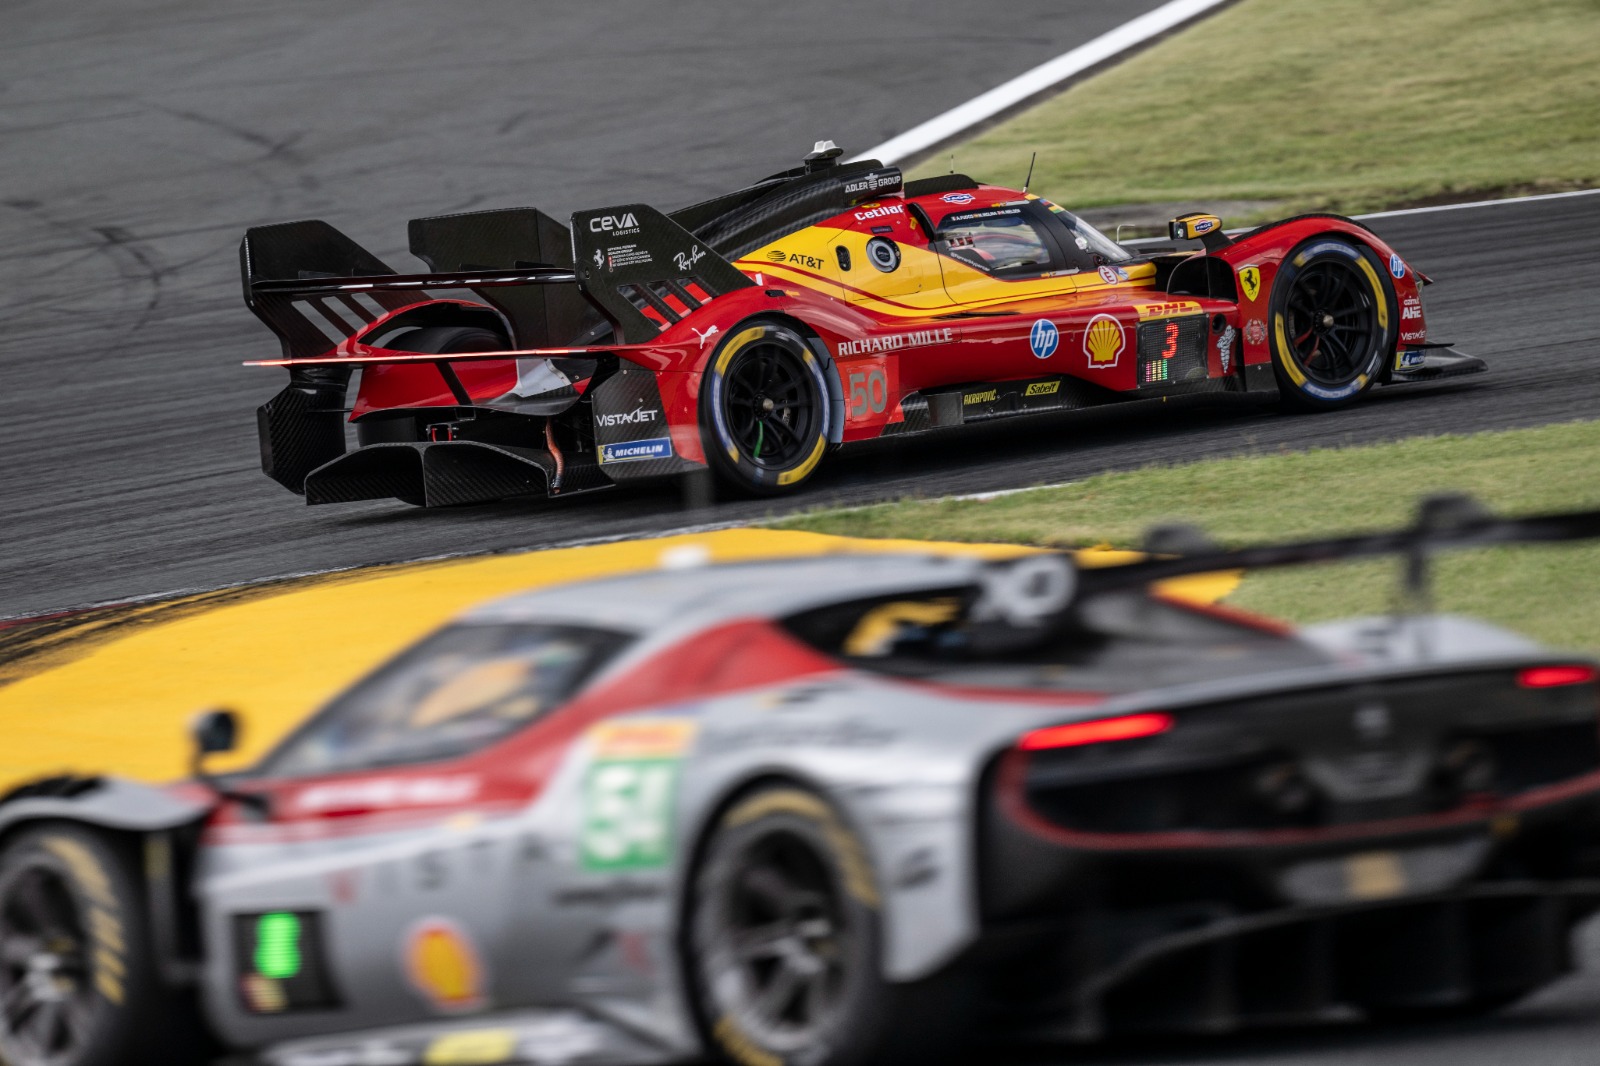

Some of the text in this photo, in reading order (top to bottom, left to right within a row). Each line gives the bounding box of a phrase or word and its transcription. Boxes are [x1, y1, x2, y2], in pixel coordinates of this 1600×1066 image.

[845, 176, 901, 193] ADLER GROUP
[612, 228, 640, 236] LOGISTICS
[789, 253, 824, 270] AT&T
[1146, 302, 1193, 317] DHL
[837, 327, 953, 356] RICHARD MILLE
[1034, 319, 1056, 358] hp
[1162, 322, 1179, 359] 3
[849, 370, 887, 417] 50
[615, 444, 664, 457] MICHELIN
